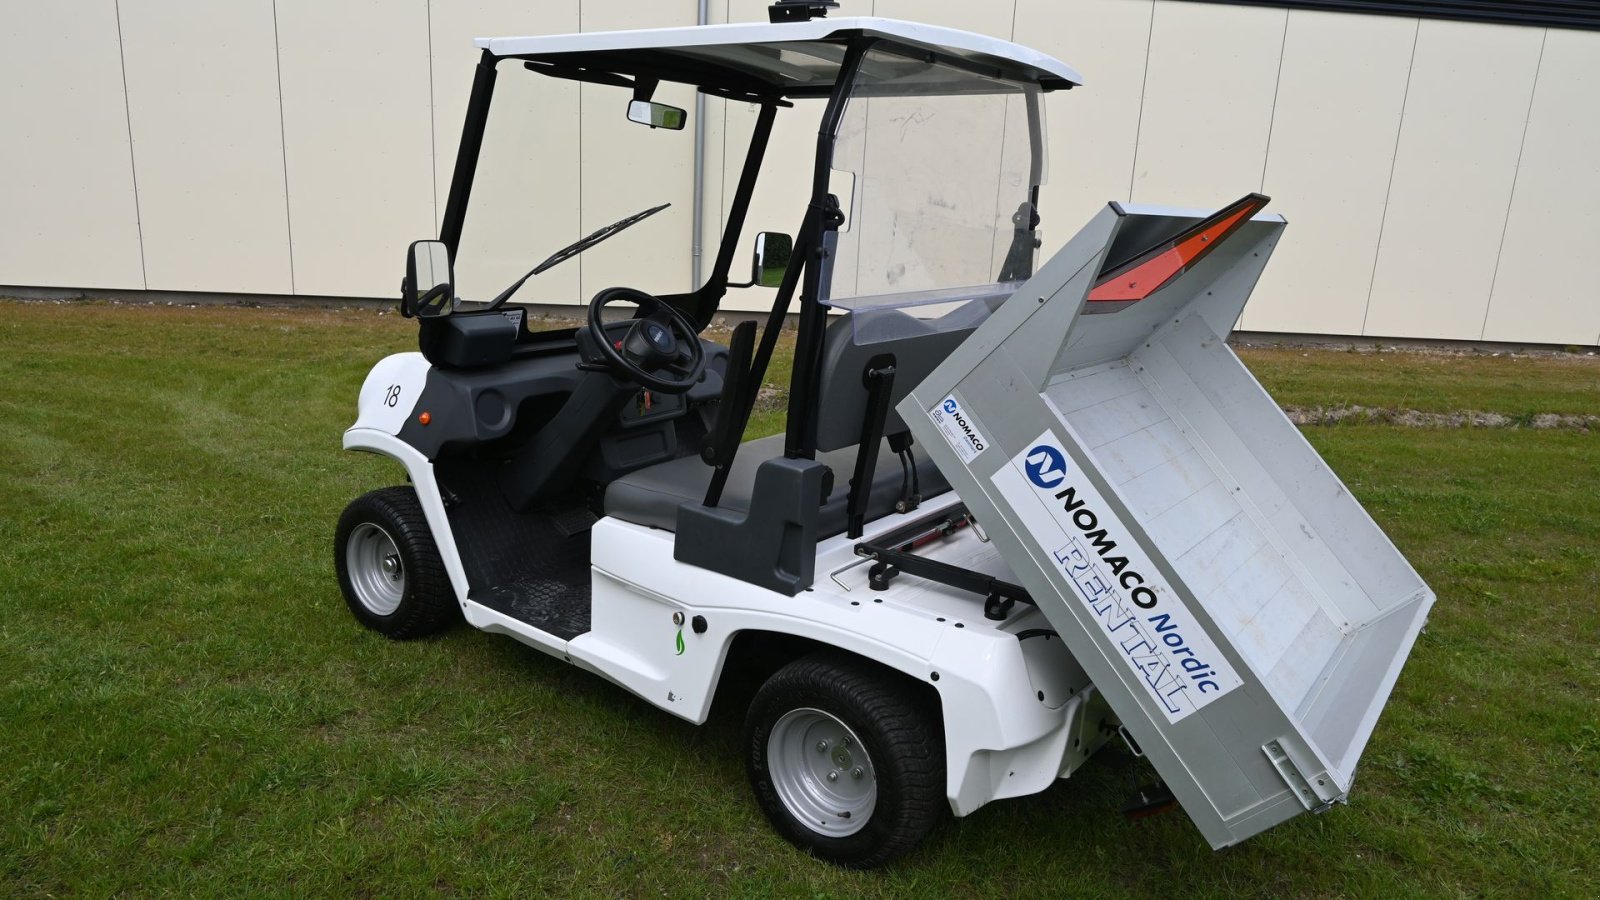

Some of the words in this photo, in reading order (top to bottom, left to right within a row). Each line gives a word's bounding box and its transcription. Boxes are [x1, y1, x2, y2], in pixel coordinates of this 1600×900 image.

[383, 383, 402, 408] 18
[952, 412, 984, 451] NOMACO
[1053, 536, 1188, 714] RENTAL
[1054, 486, 1158, 610] NOMACO
[1148, 613, 1220, 694] Nordic
